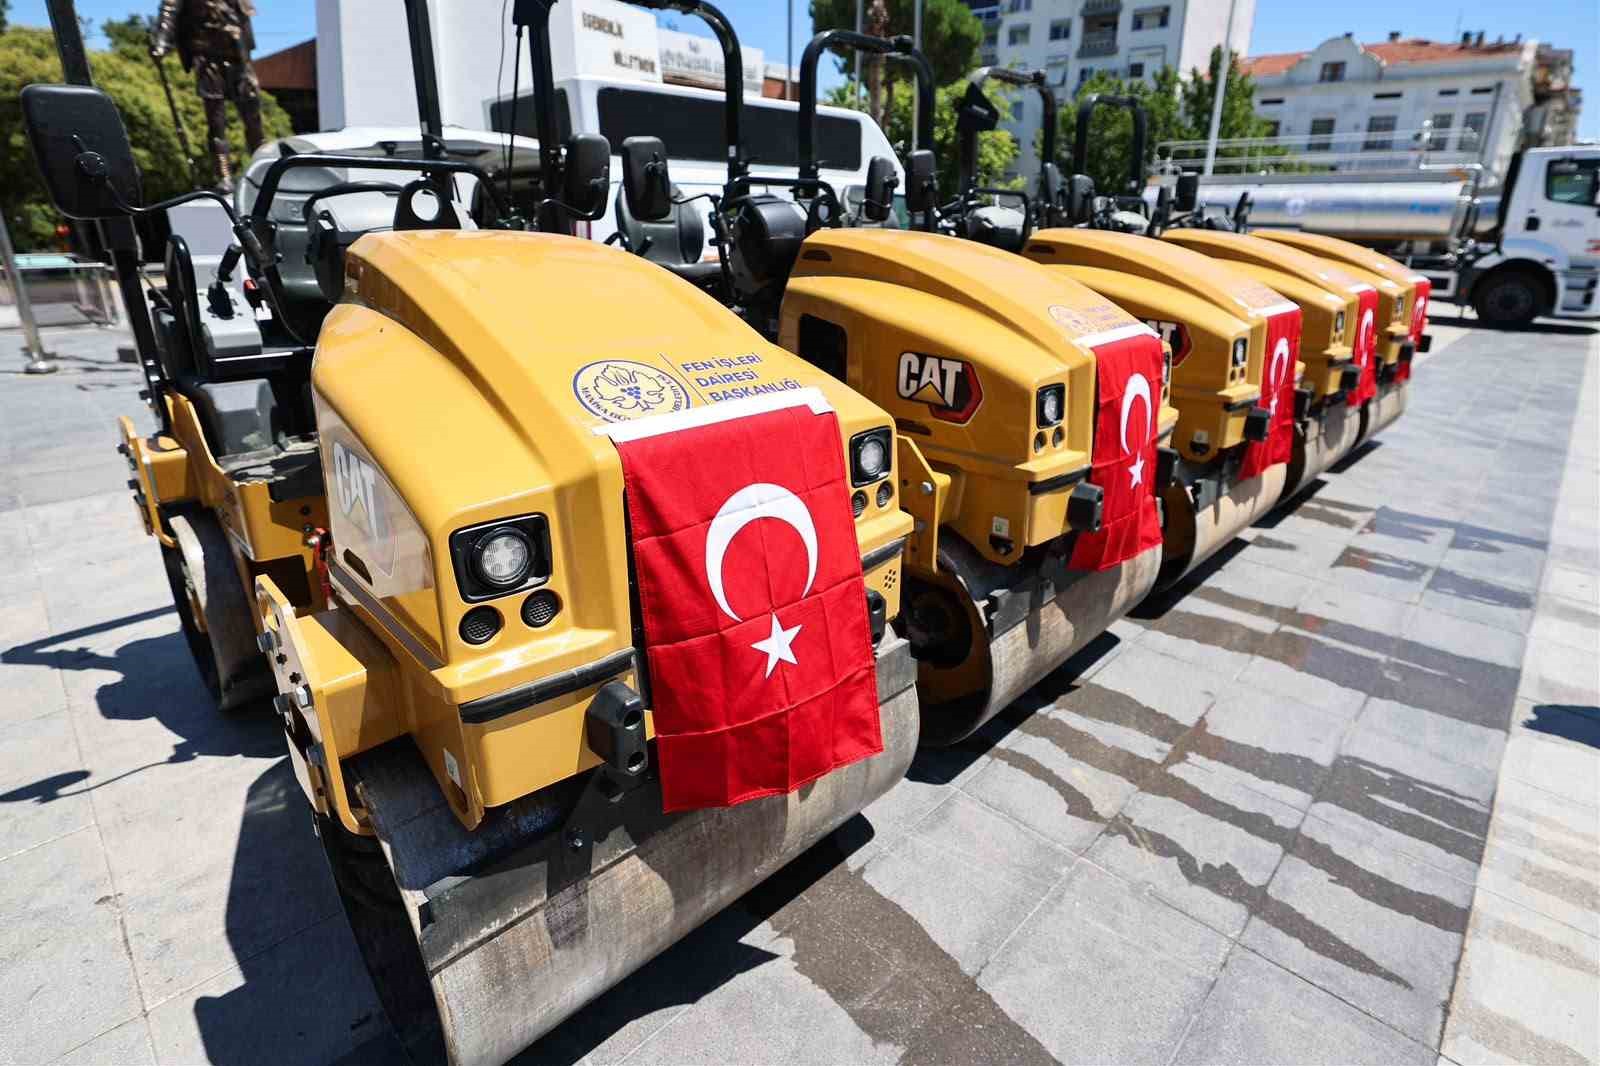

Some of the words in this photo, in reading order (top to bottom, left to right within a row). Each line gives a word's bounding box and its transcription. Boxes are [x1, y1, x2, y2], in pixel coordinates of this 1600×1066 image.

[682, 361, 716, 372] FEN
[713, 352, 763, 368] İŞLERİ
[696, 368, 760, 388] DAİRESİ
[709, 378, 802, 402] BAŞKANLIĞI
[898, 352, 963, 407] CAT
[333, 442, 376, 543] CAT
